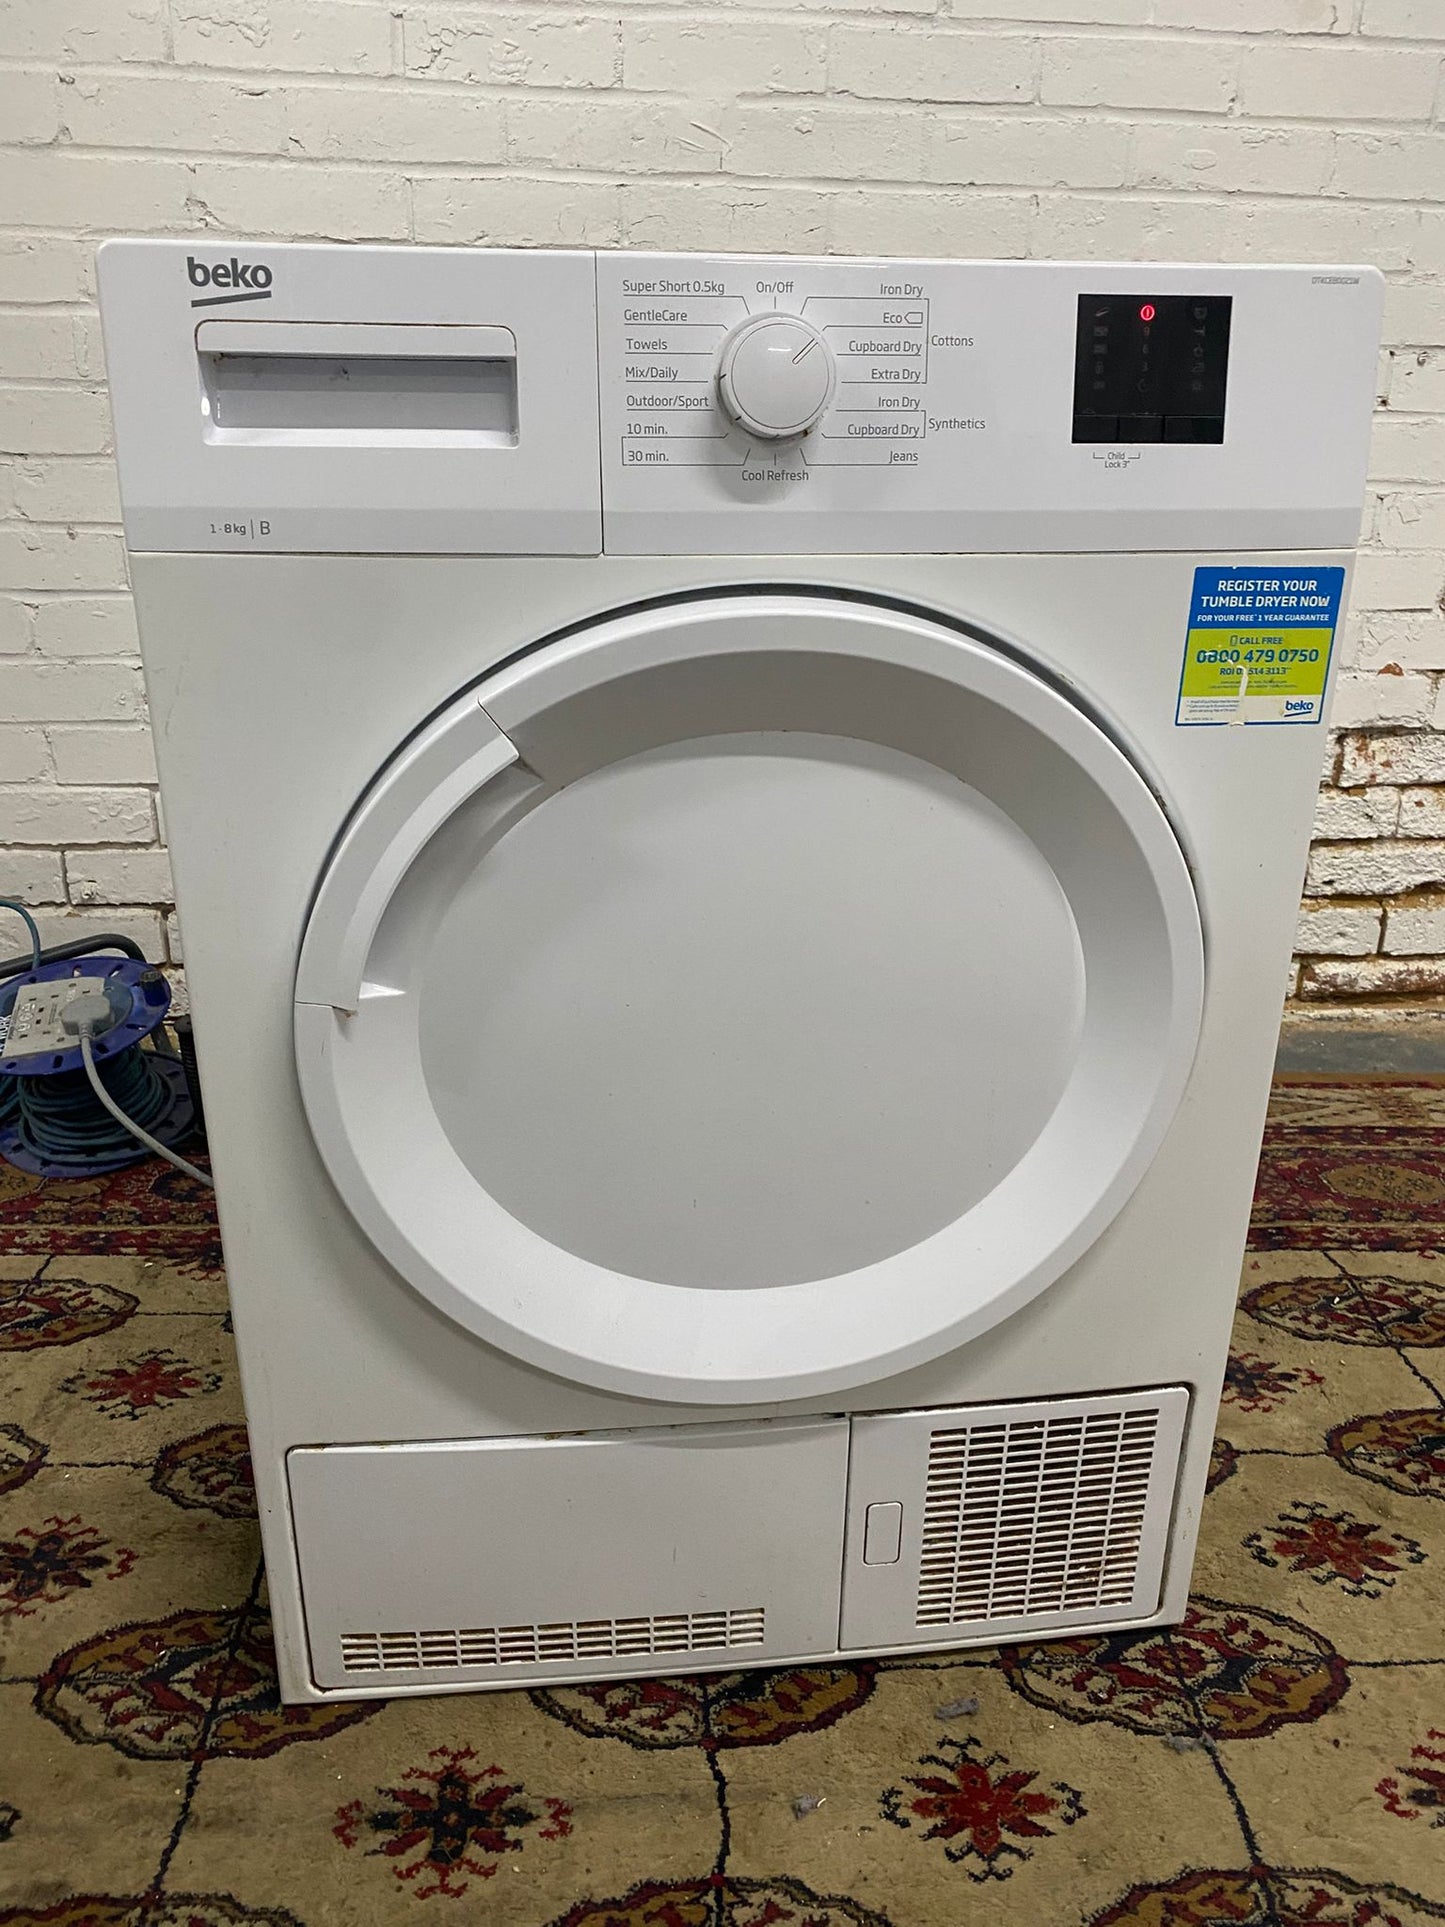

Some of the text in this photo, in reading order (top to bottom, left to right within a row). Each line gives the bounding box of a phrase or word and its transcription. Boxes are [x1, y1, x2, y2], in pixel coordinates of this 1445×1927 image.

[187, 257, 272, 288] beko
[623, 280, 725, 295] Super Short 0.5kg
[756, 281, 794, 294] On/Off
[880, 284, 923, 298] Iron Dry
[624, 309, 688, 321] GentleCare
[883, 312, 903, 323] Eco
[626, 338, 668, 350] Towels
[931, 335, 974, 347] Cottons
[849, 341, 922, 356] Cupboard Dry
[625, 367, 678, 381] Mix/Daily
[871, 369, 921, 383] Extra Dry
[626, 395, 709, 410] Outdoor/Sport
[878, 397, 920, 411] Iron Dry
[627, 424, 668, 435] 10 min.
[848, 424, 920, 438] Cupboard Dry
[928, 418, 986, 433] Synthetics
[628, 451, 669, 461] 30 min.
[889, 451, 918, 464] Jeans
[1107, 452, 1125, 460] Child
[1105, 460, 1121, 469] Lock
[742, 470, 809, 481] Cool Refresh
[260, 520, 271, 535] B
[1218, 580, 1317, 592] REGISTER YOUR
[1201, 596, 1330, 607] TUMBLE DRYER NOW
[1240, 637, 1284, 645] CALL FREE
[1196, 649, 1319, 663] 0800 479 0750
[1285, 700, 1314, 711] beko
